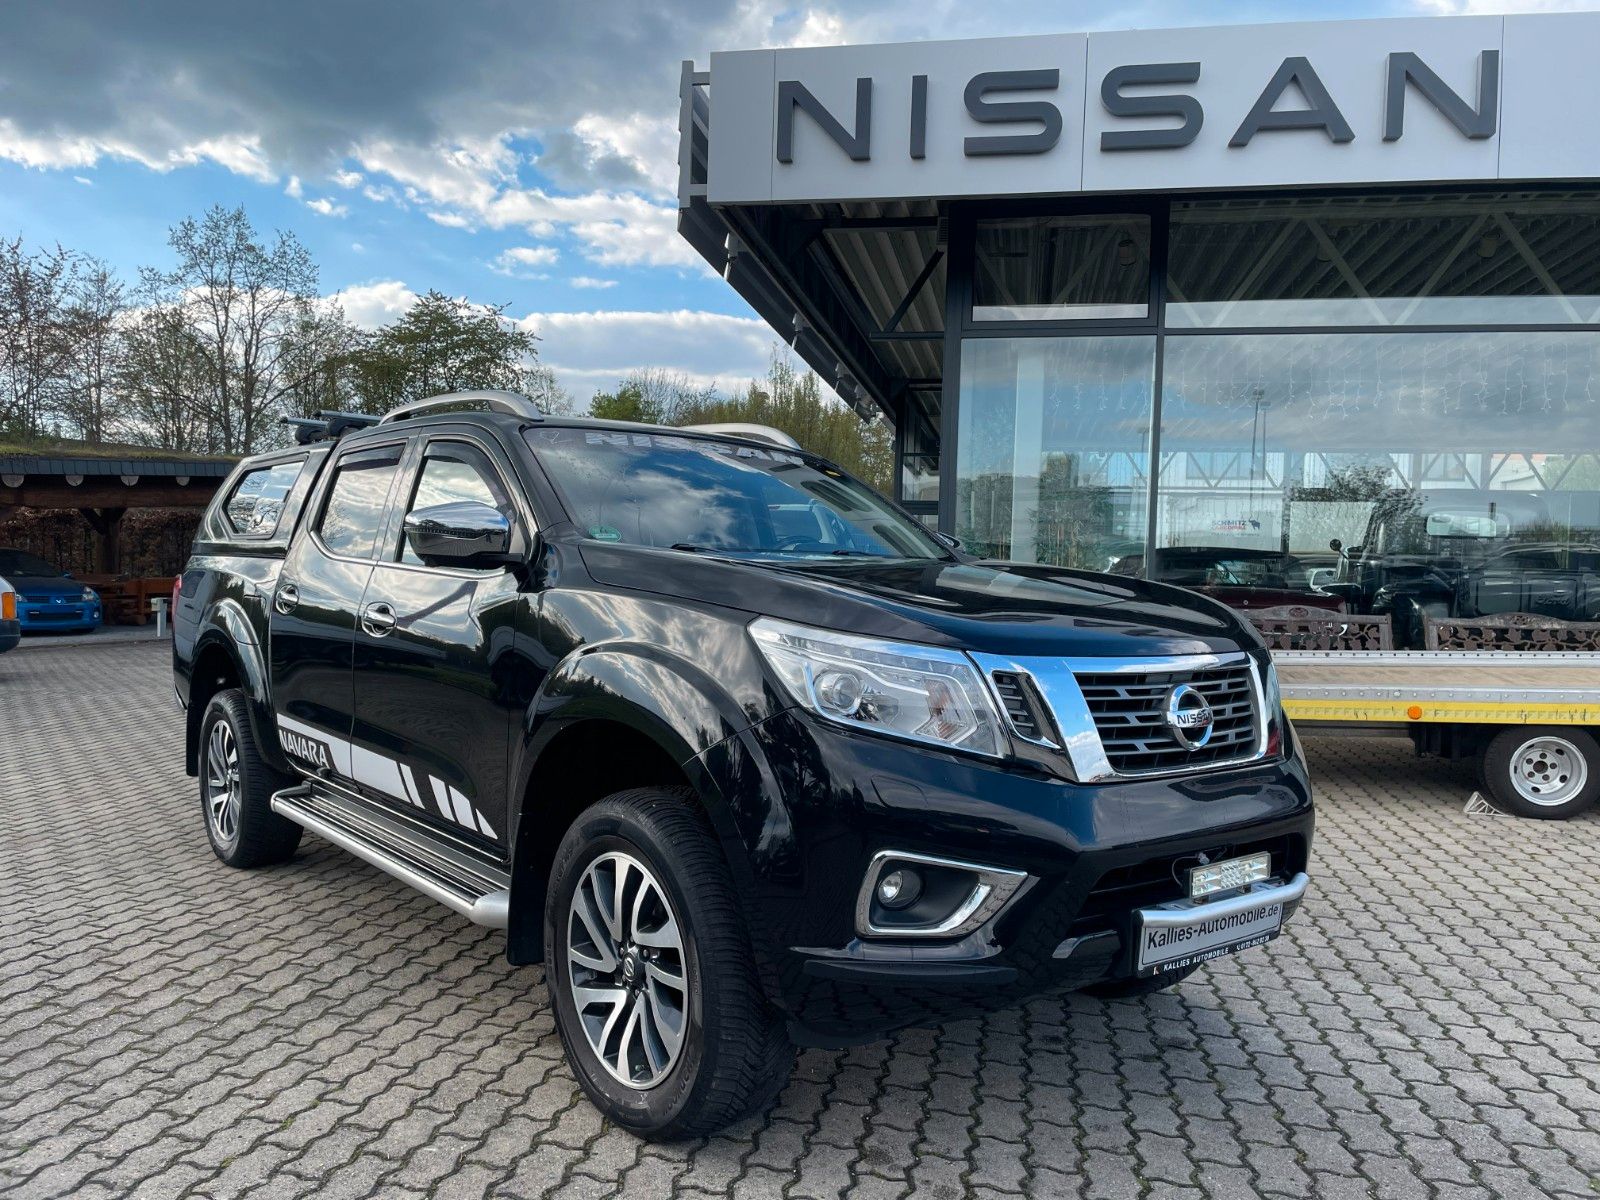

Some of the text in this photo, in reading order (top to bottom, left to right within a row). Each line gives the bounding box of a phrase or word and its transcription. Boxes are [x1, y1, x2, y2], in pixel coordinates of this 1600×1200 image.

[776, 49, 1500, 165] NISSAN
[1177, 708, 1212, 725] NISS
[278, 729, 330, 769] NAVARA
[1147, 905, 1279, 950] Kallies-Automobile.de
[1163, 958, 1190, 972] KALLIES
[1192, 947, 1229, 964] AUTOMOBILE
